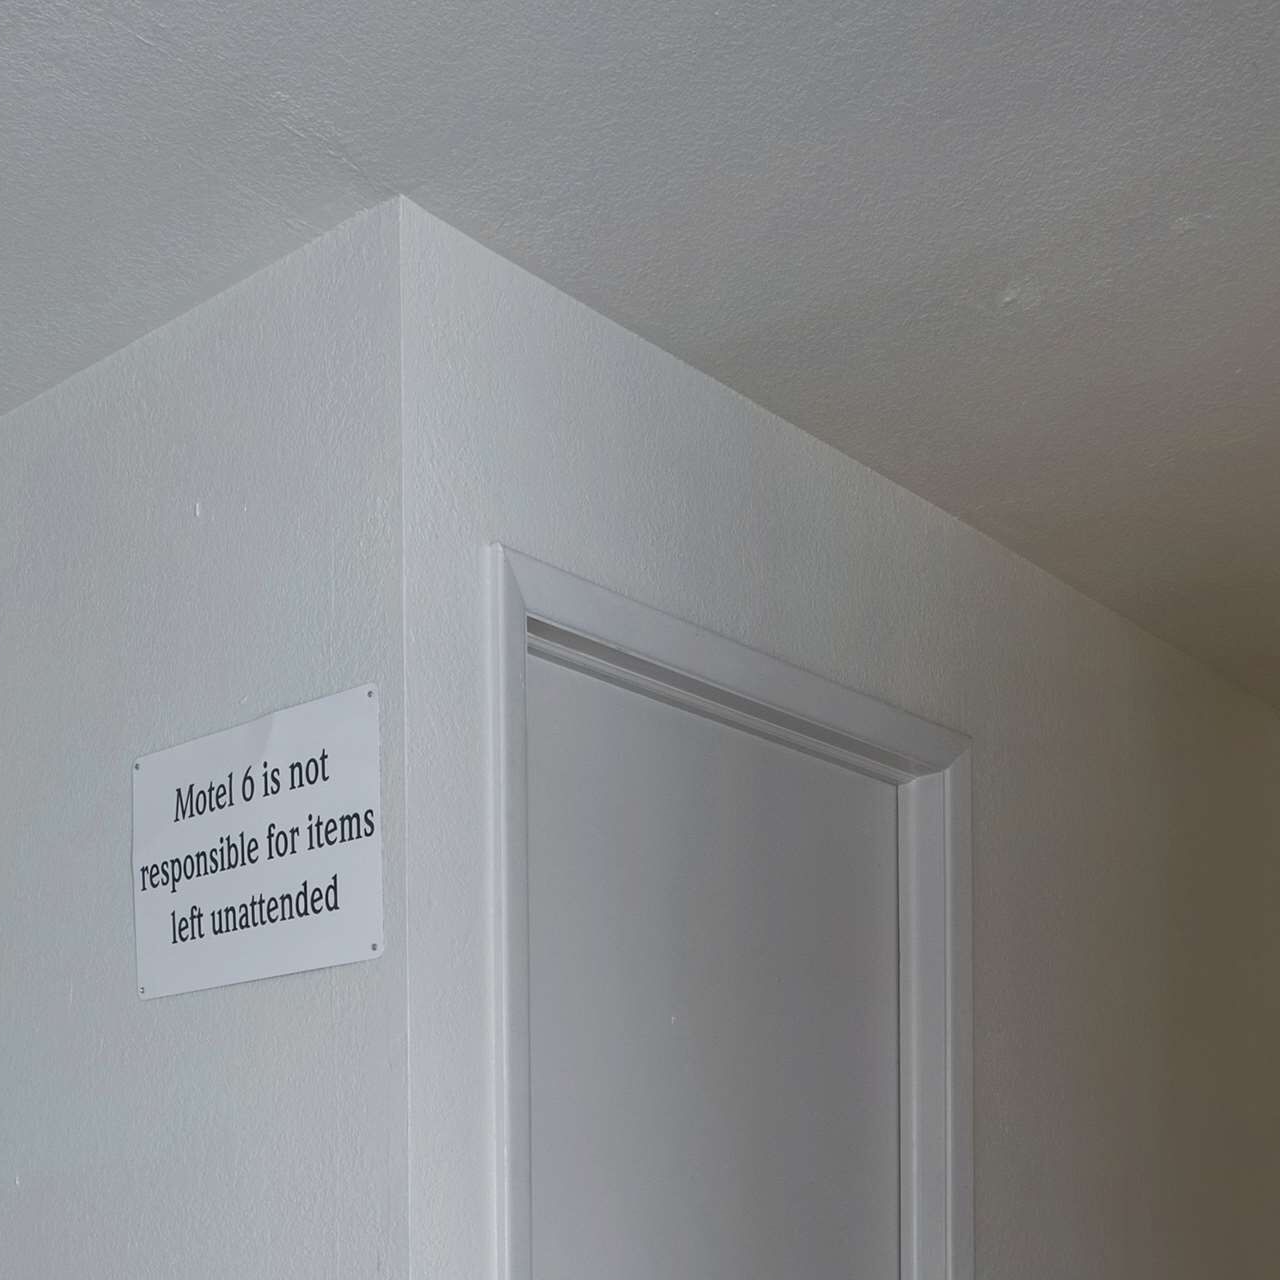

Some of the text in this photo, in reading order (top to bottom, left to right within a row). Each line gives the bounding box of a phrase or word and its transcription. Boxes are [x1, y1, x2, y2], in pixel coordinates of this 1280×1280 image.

[174, 748, 330, 823] Motel 6 is not
[140, 808, 375, 893] responsible for items
[170, 874, 340, 944] left unattended
